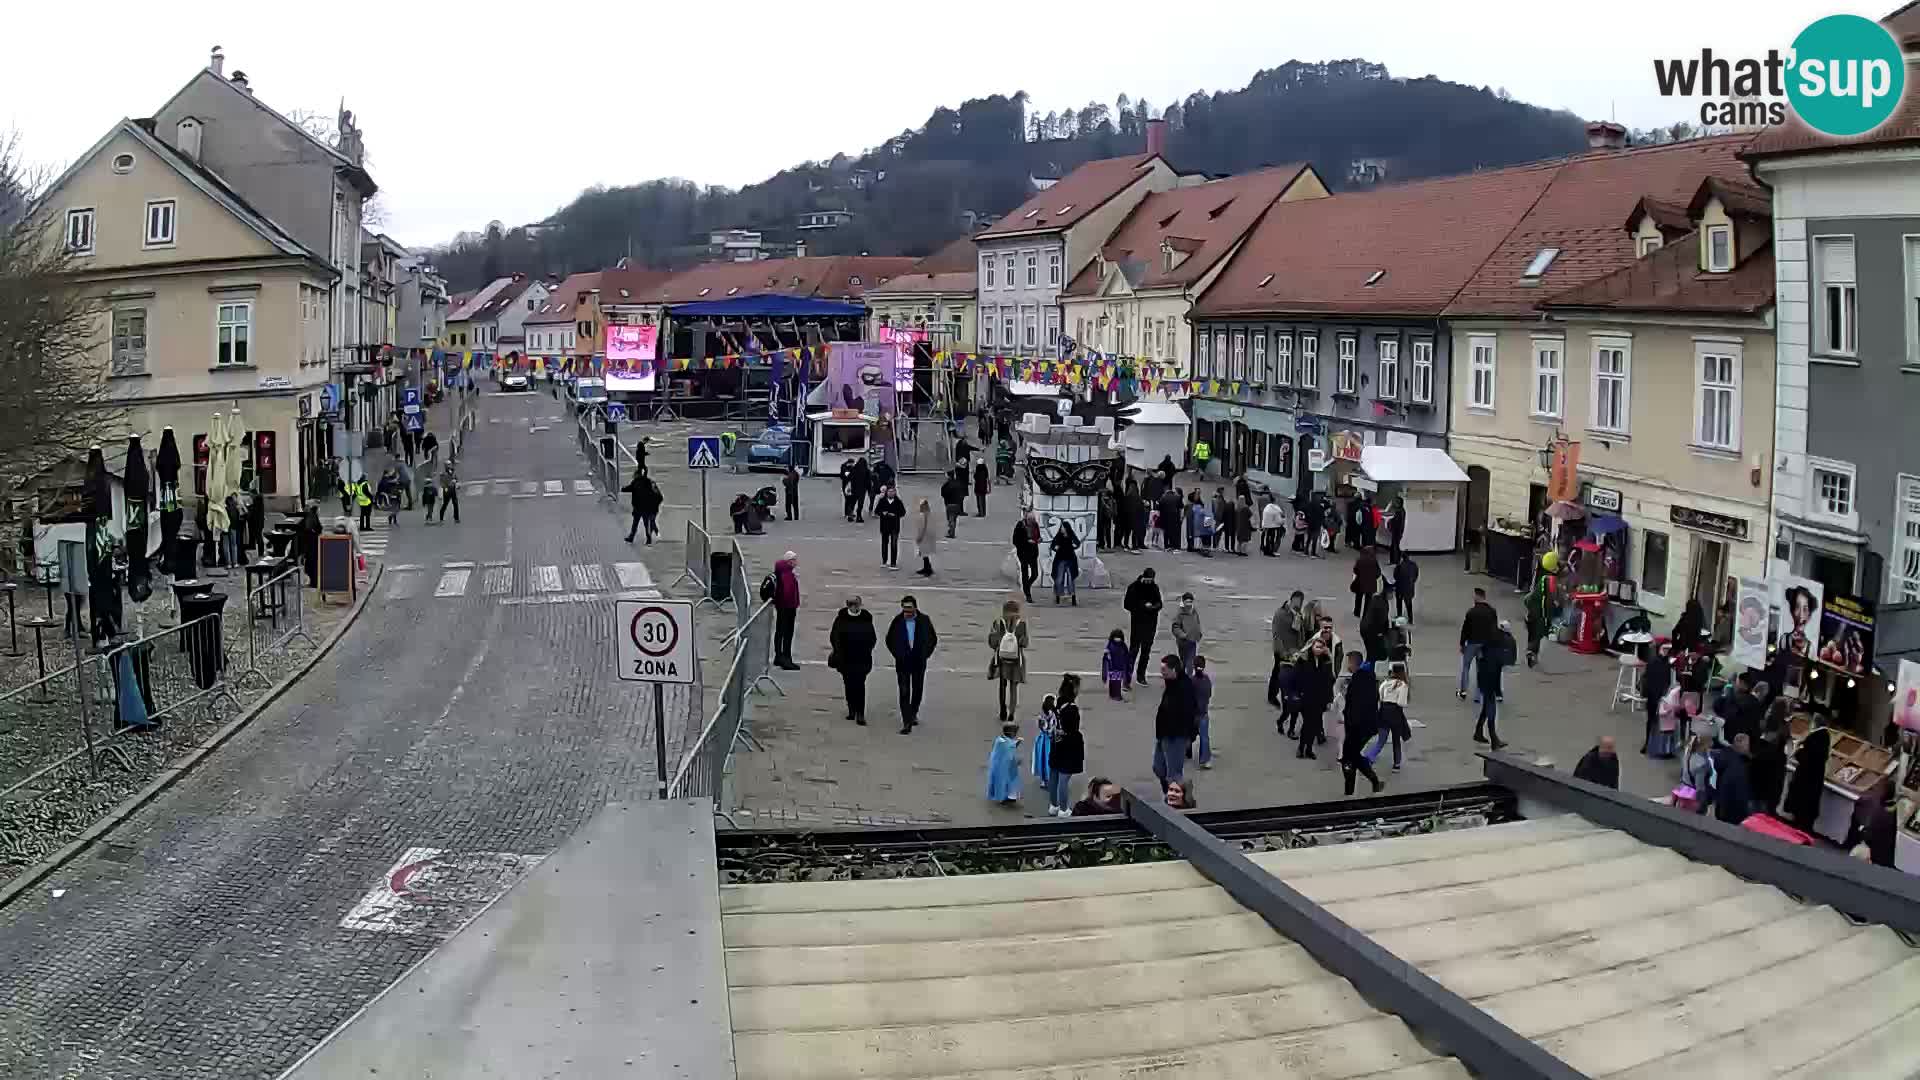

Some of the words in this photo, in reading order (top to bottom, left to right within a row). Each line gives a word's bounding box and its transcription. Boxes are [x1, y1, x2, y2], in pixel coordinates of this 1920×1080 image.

[407, 391, 416, 402] P
[643, 622, 667, 643] 30
[633, 659, 678, 676] ZONA
